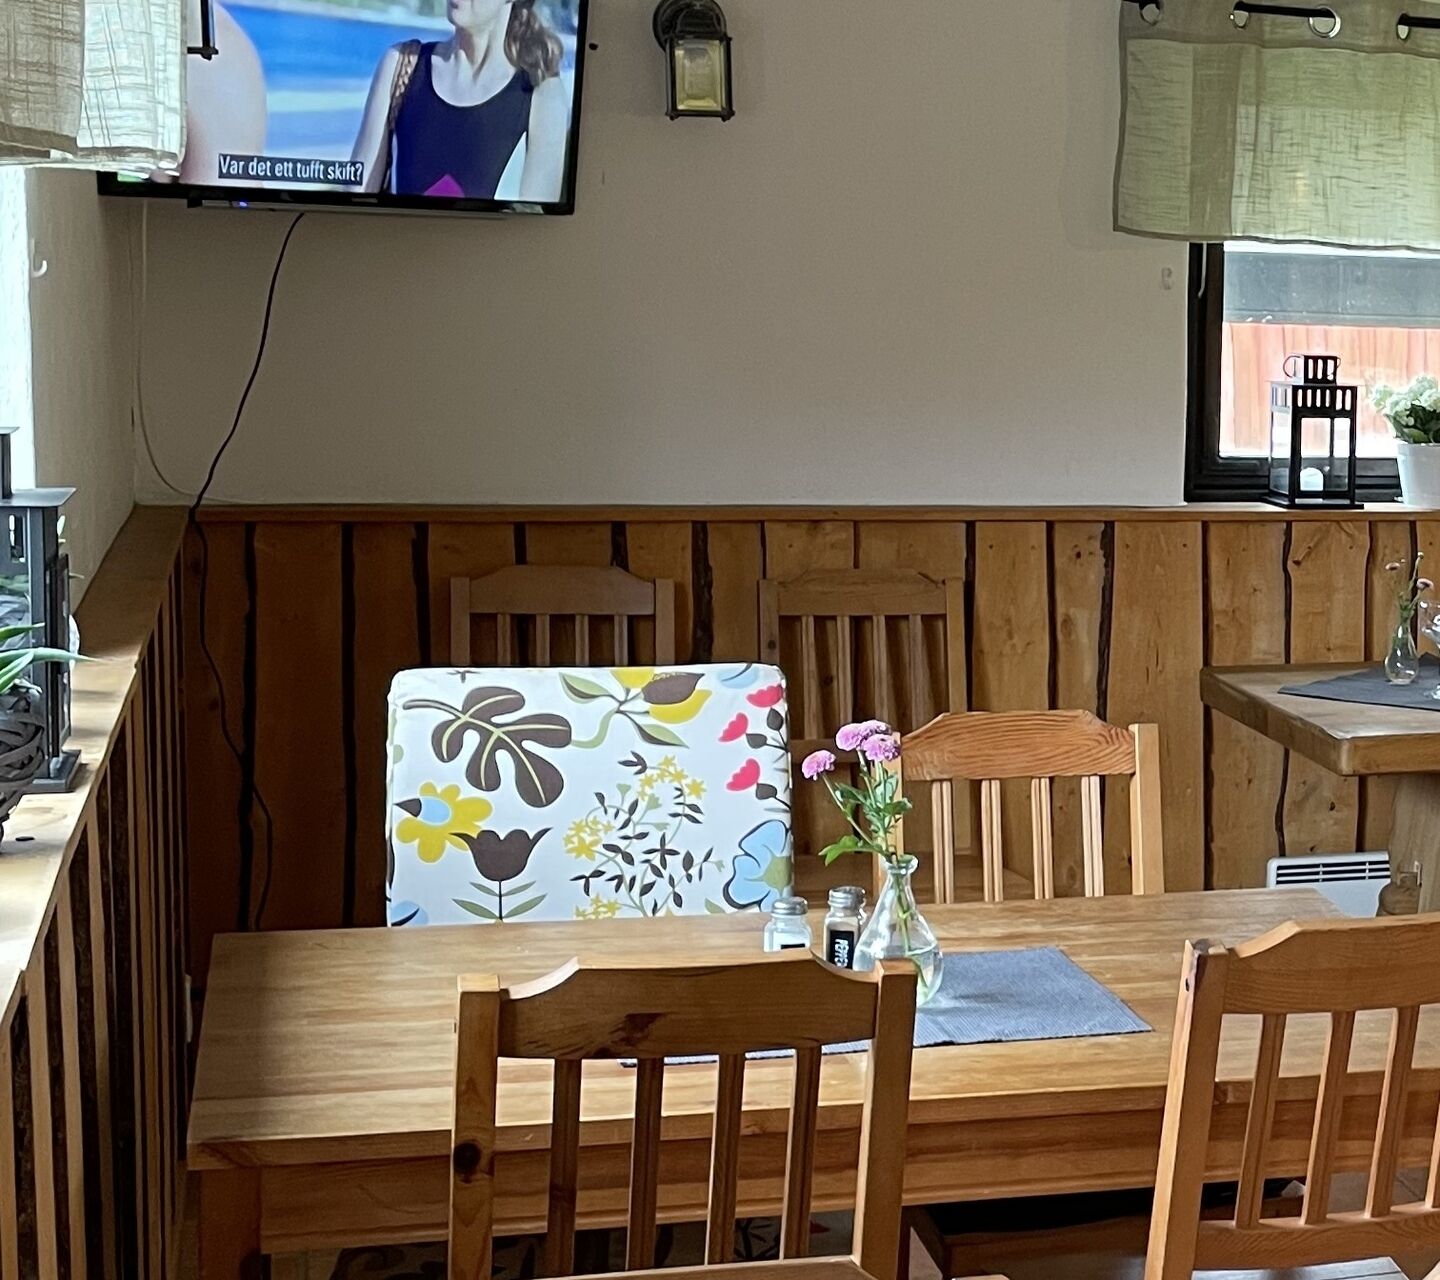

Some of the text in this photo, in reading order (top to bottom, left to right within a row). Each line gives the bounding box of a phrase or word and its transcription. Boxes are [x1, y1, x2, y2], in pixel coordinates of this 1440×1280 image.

[219, 155, 363, 182] Var det ett tufft skift?
